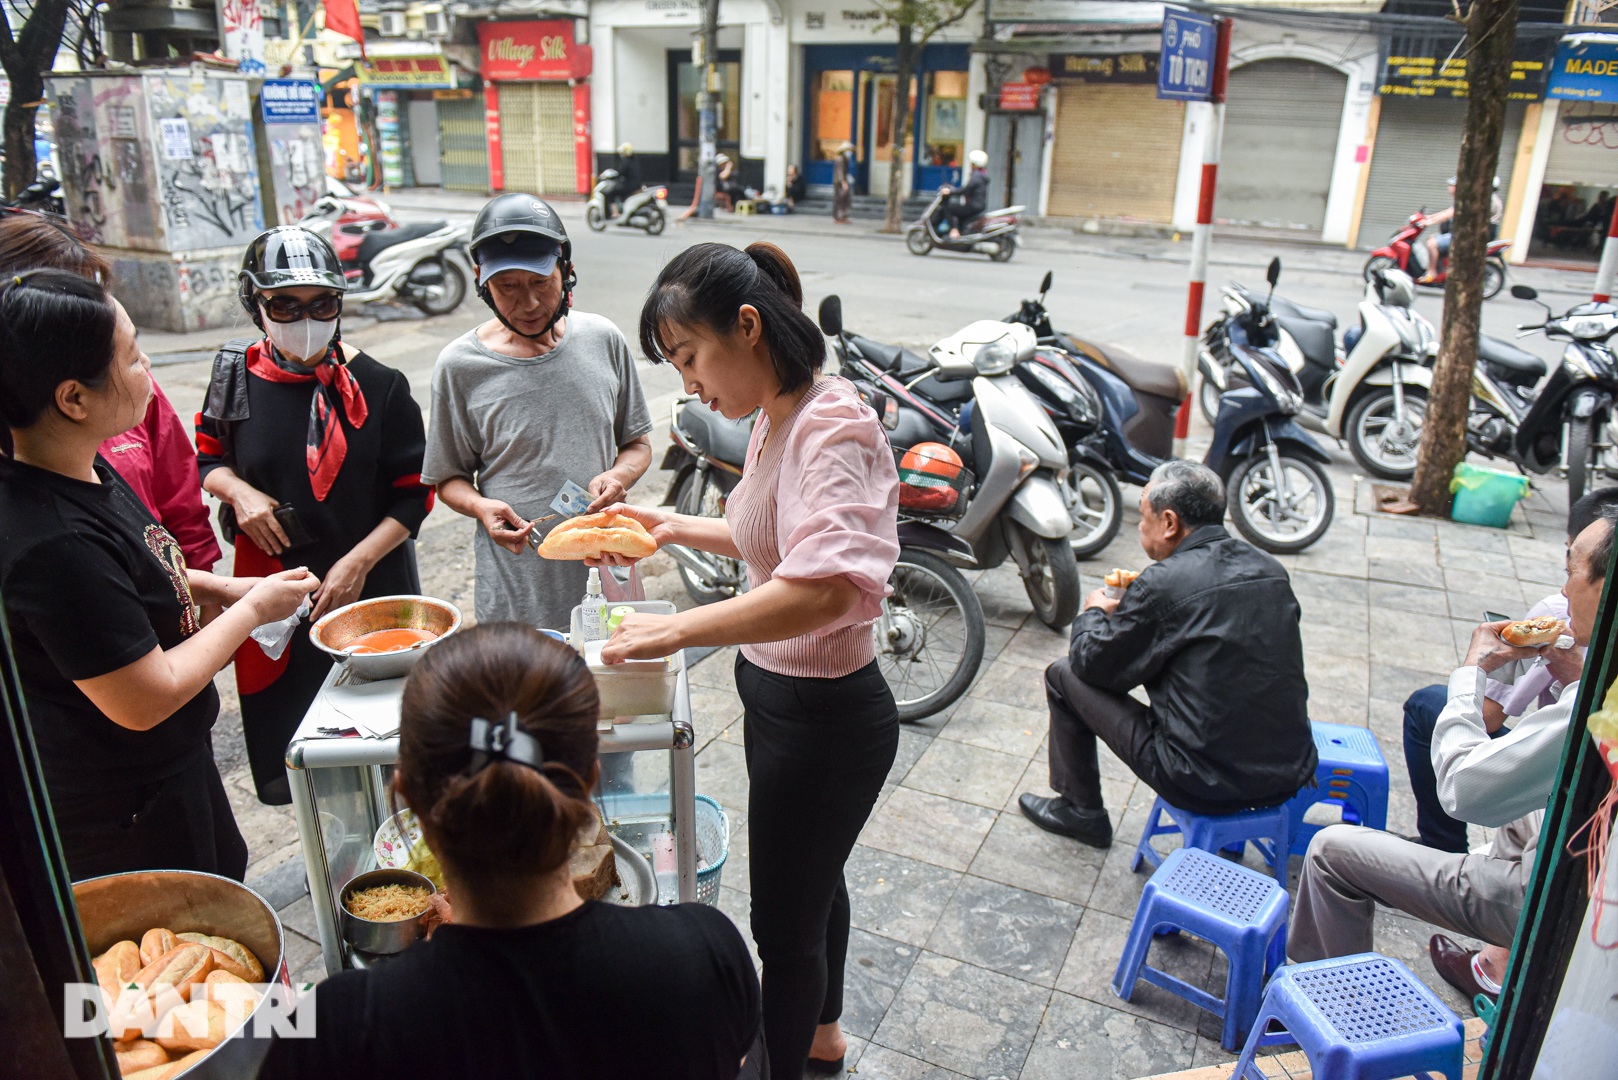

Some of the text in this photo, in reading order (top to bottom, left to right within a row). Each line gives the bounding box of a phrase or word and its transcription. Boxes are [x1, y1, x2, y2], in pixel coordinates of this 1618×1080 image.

[487, 36, 568, 68] Village Silk
[1565, 59, 1618, 76] MADE
[1184, 57, 1208, 93] TỊCH
